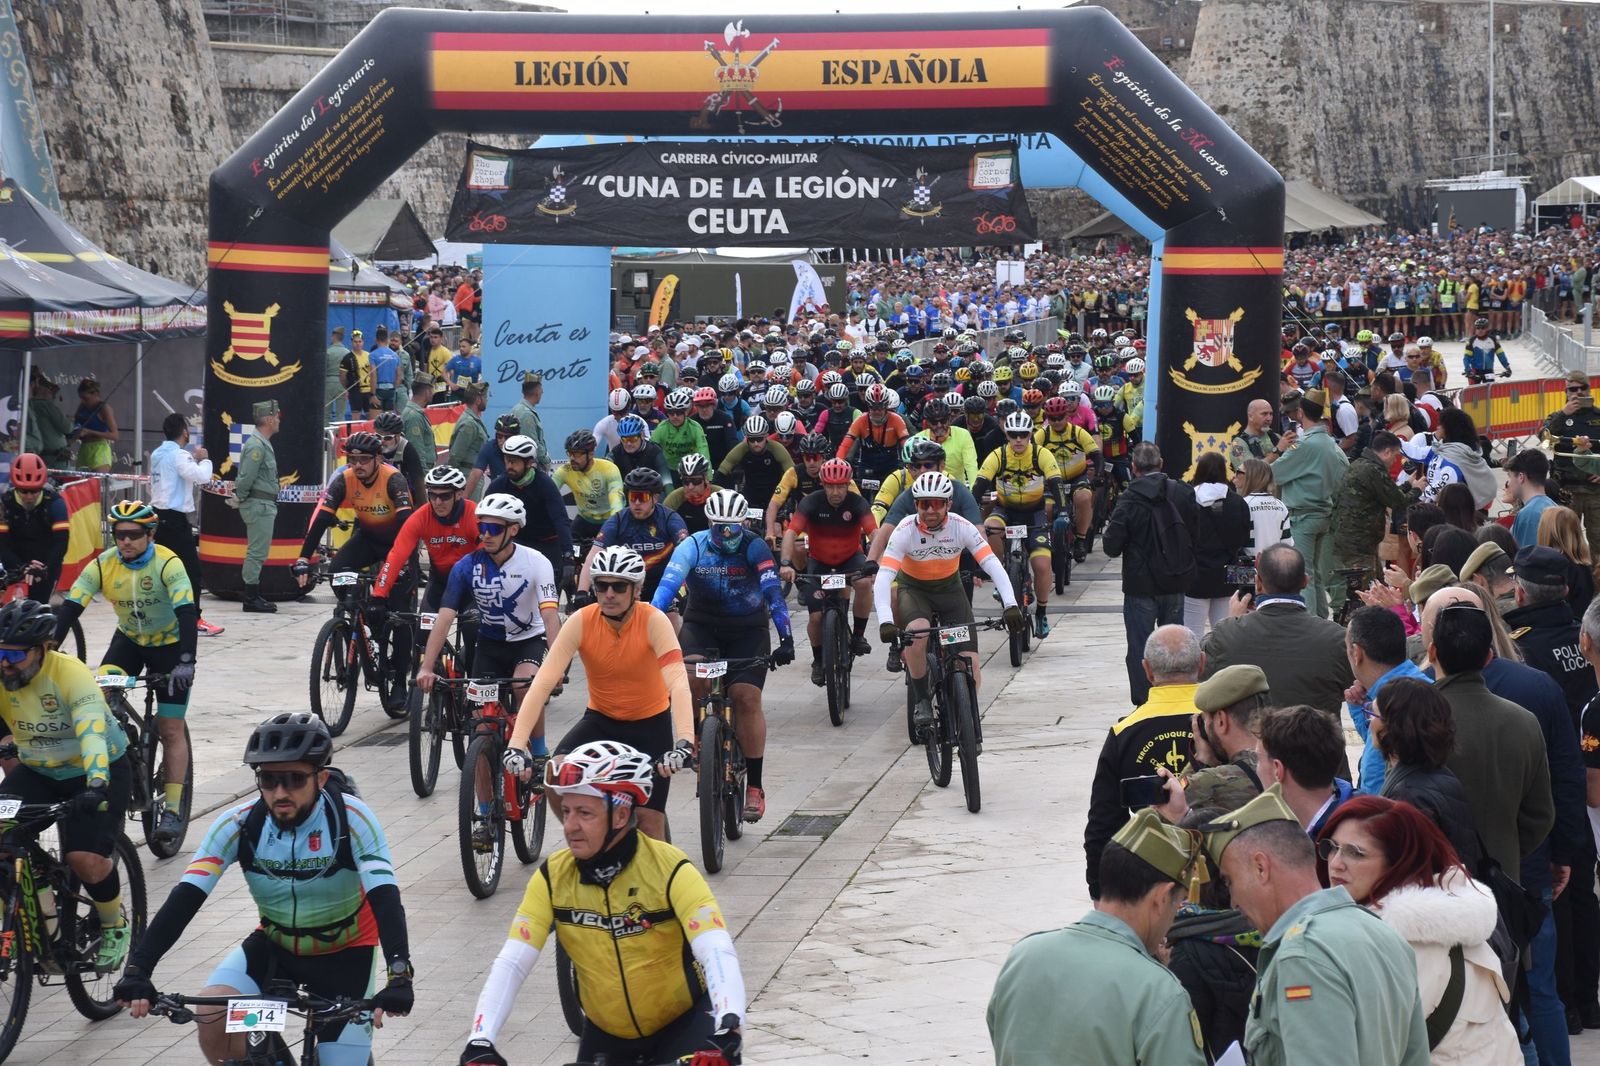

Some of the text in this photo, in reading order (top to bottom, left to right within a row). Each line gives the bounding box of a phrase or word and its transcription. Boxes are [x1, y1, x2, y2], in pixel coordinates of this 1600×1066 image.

[514, 55, 630, 86] LEGIÓN
[822, 54, 988, 86] ESPAÑOLA
[250, 59, 374, 176] Espíritu del Legionario
[1104, 56, 1228, 176] Espíritu de la Muerte
[475, 158, 490, 168] The
[660, 150, 818, 164] CARRERA CÍVICO-MILITAR
[978, 160, 994, 168] The
[474, 168, 505, 176] Corner
[978, 167, 1010, 176] Corner
[474, 176, 495, 185] Shop
[690, 178, 724, 198] DE
[732, 178, 770, 198] LA
[978, 175, 1001, 186] Shop
[688, 208, 790, 234] CEUTA
[494, 320, 591, 348] Ceuta es
[498, 358, 592, 384] Deorte
[952, 630, 967, 638] 162
[1552, 644, 1580, 660] POLI
[1562, 656, 1594, 672] LOCA
[1136, 740, 1154, 764] TERCIO
[614, 924, 645, 936] CLUB
[256, 1010, 275, 1022] 14
